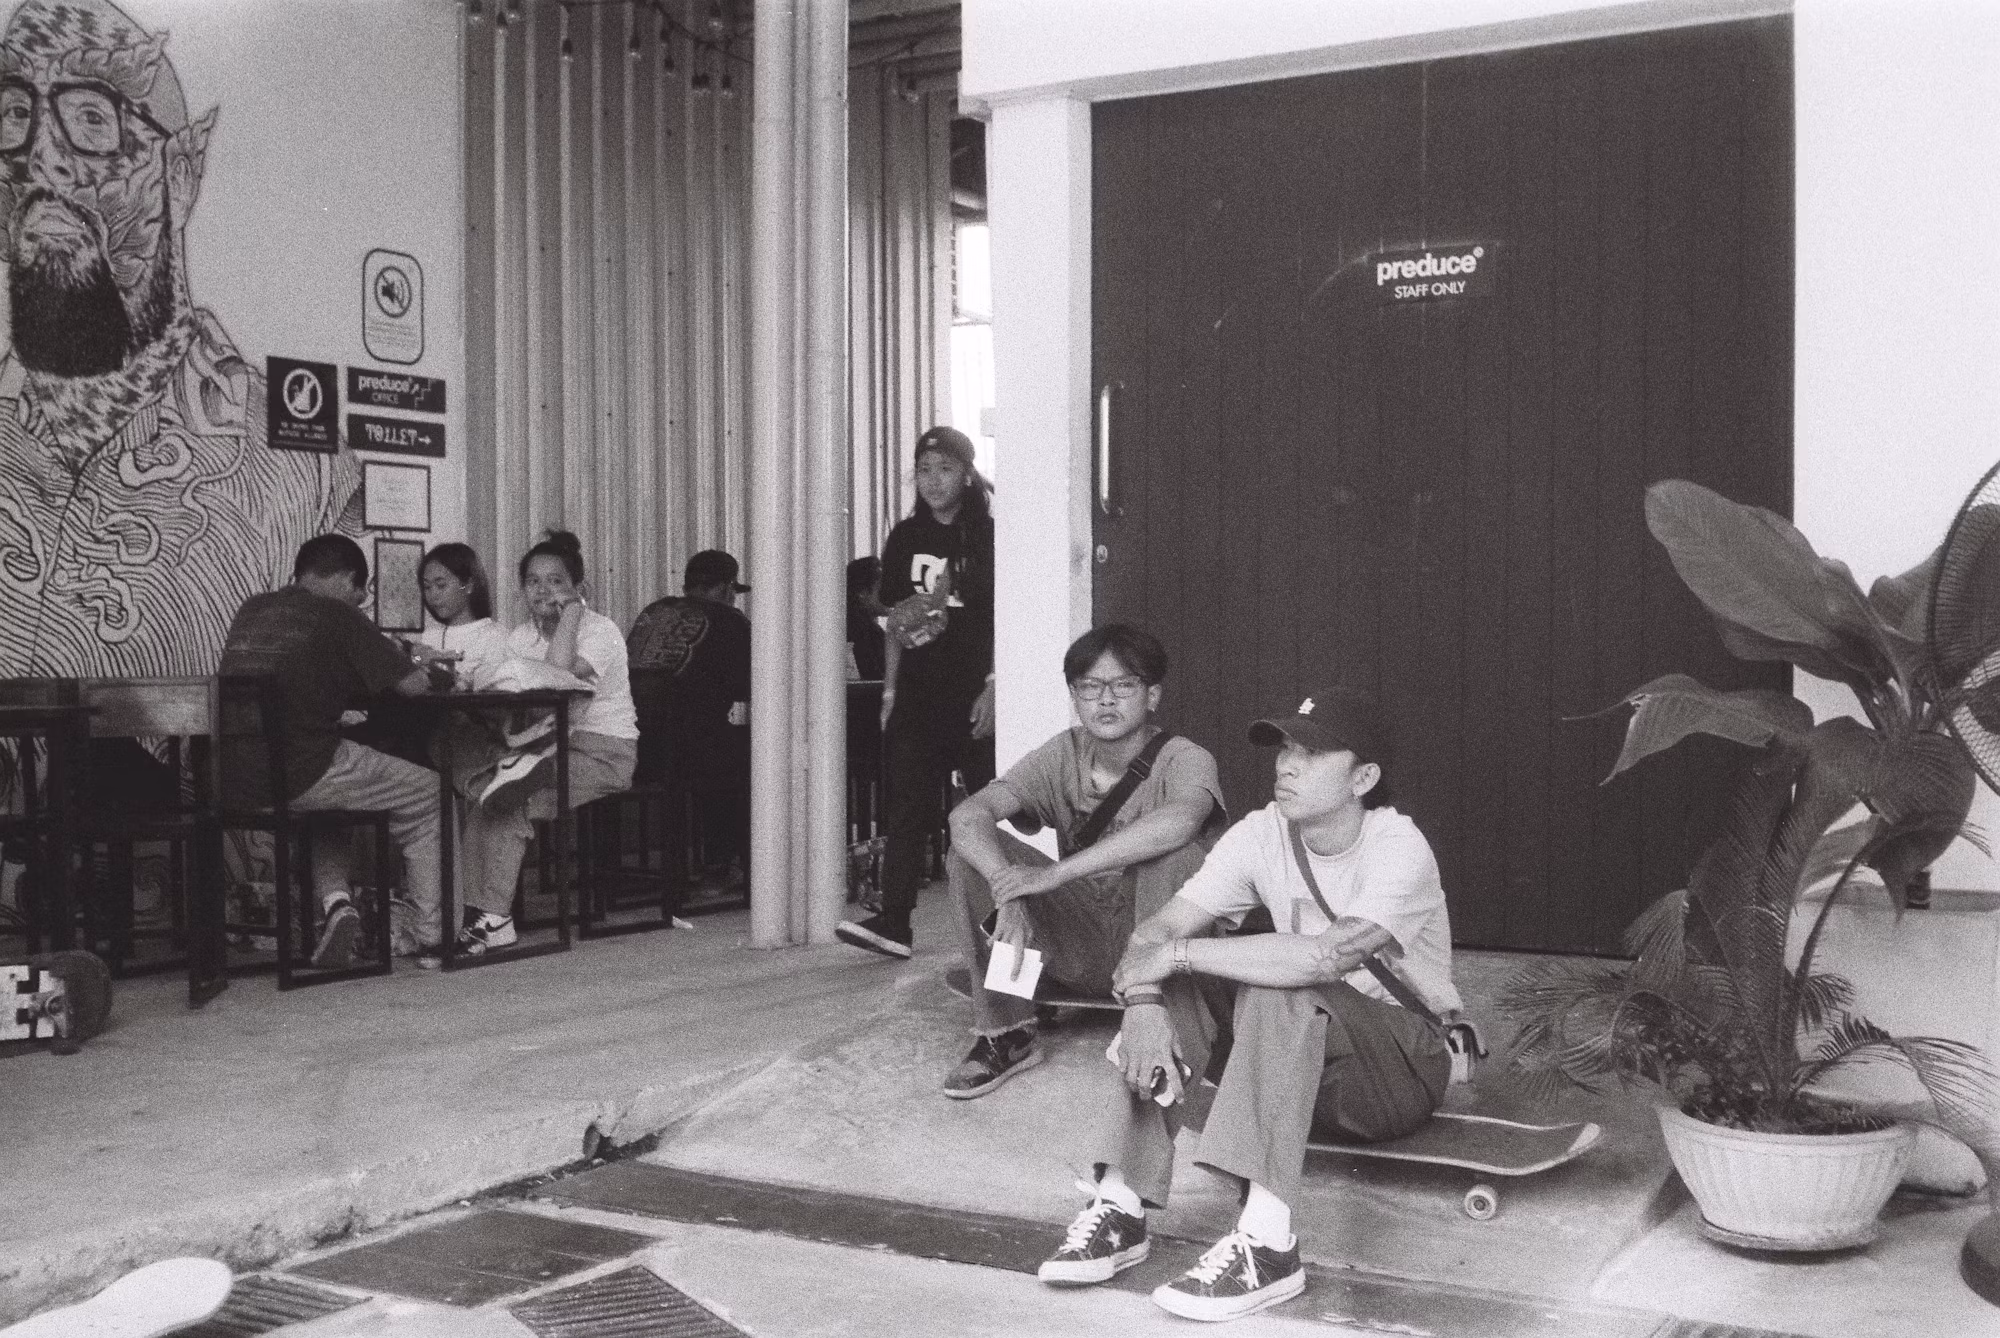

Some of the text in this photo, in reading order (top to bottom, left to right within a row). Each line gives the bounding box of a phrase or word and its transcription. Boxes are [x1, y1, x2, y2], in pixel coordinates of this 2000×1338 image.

[1394, 280, 1466, 299] STAFF ONLY
[364, 423, 418, 447] TOILET
